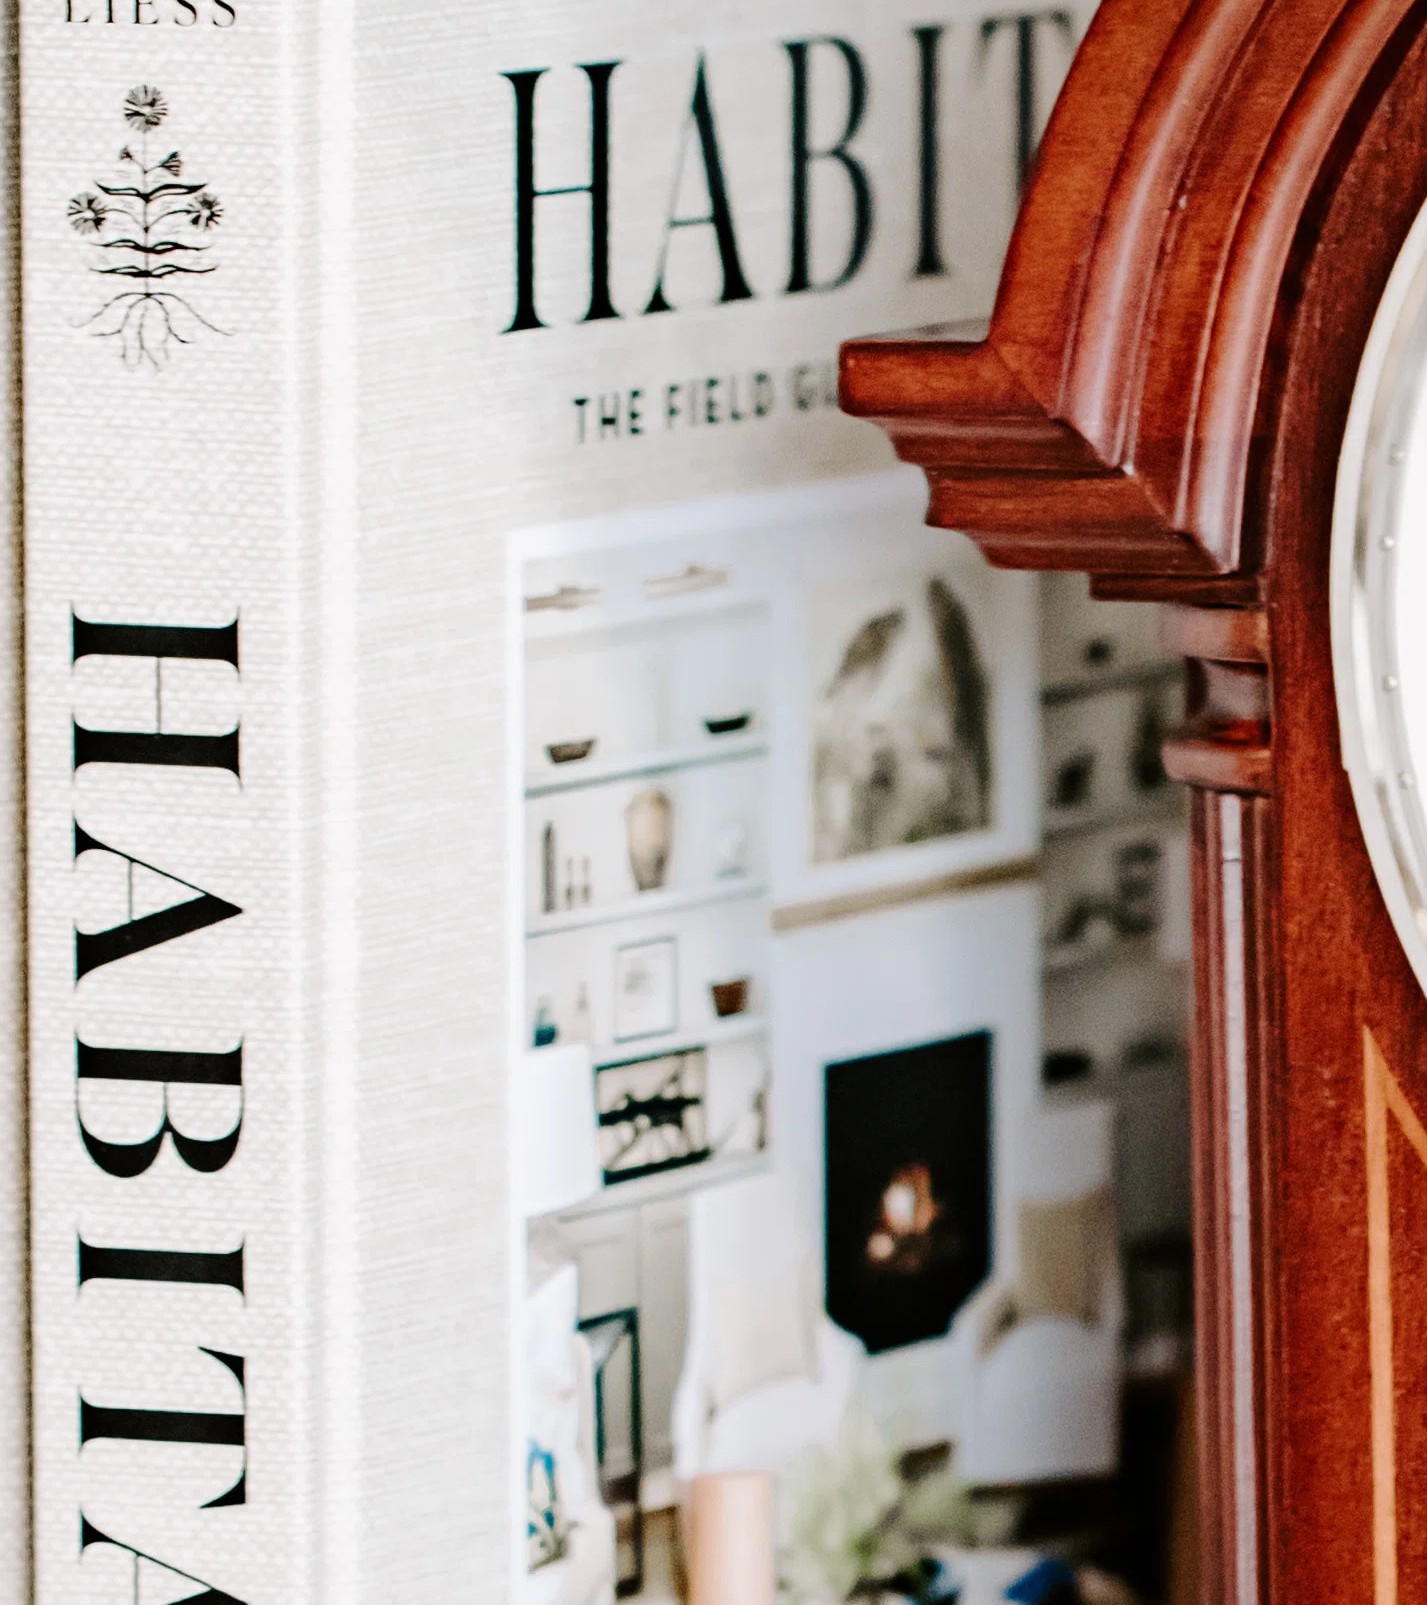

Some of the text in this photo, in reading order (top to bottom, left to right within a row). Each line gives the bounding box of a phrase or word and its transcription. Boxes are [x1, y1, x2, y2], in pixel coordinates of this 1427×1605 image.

[500, 8, 1076, 332] HABIT
[573, 390, 641, 443] THE
[663, 371, 774, 428] FIELD
